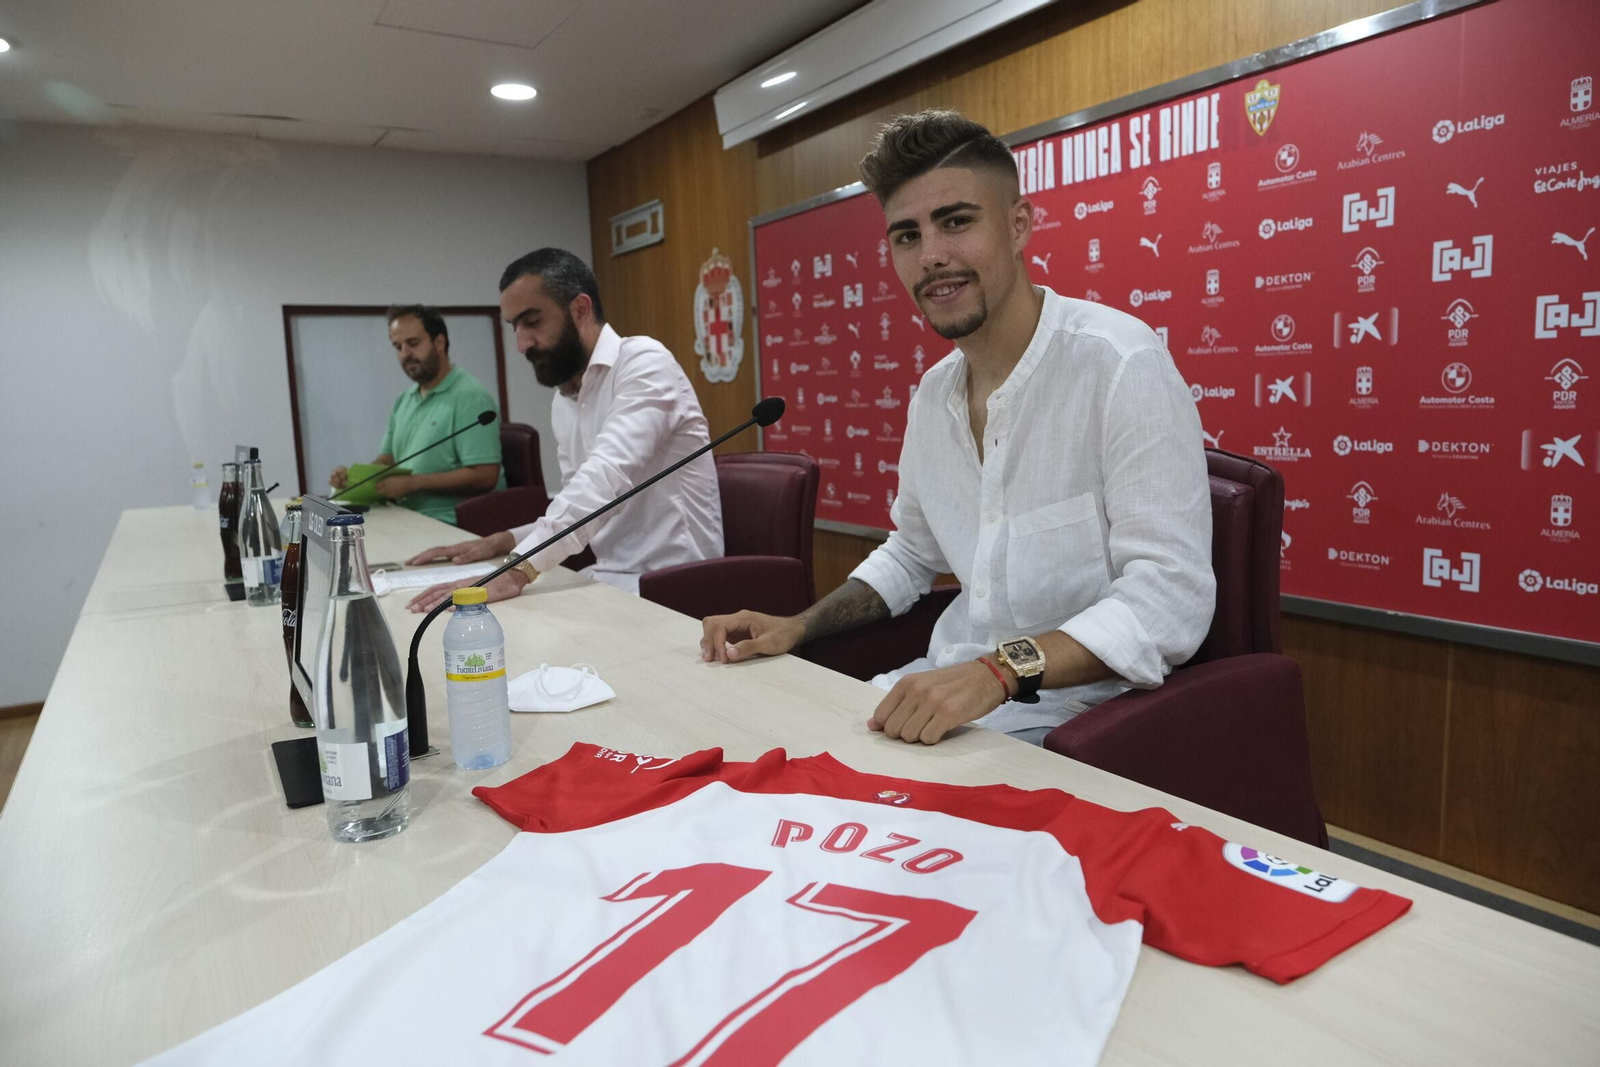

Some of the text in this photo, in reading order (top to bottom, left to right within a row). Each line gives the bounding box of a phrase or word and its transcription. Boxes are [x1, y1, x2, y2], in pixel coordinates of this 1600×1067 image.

[1457, 114, 1505, 134] LaLiga
[1062, 122, 1122, 187] NUNCA
[1129, 113, 1151, 169] SE
[1159, 92, 1221, 163] RINDE
[1337, 150, 1406, 170] Arabian Centres
[1535, 161, 1578, 176] VIAJES
[1277, 217, 1313, 232] LaLiga
[1266, 272, 1312, 286] DEKTON
[1204, 385, 1235, 399] LaLiga
[1419, 394, 1495, 404] Automotor Costa
[1253, 446, 1312, 458] ESTRELLA
[1354, 439, 1393, 454] LaLiga
[1432, 442, 1490, 455] DEKTON
[1415, 515, 1491, 530] Arabian Centres
[1540, 528, 1581, 540] ALMERÍA
[1340, 550, 1390, 566] DEKTON
[1546, 576, 1599, 596] LaLiga
[771, 818, 965, 875] POZO
[481, 862, 979, 1067] 17
